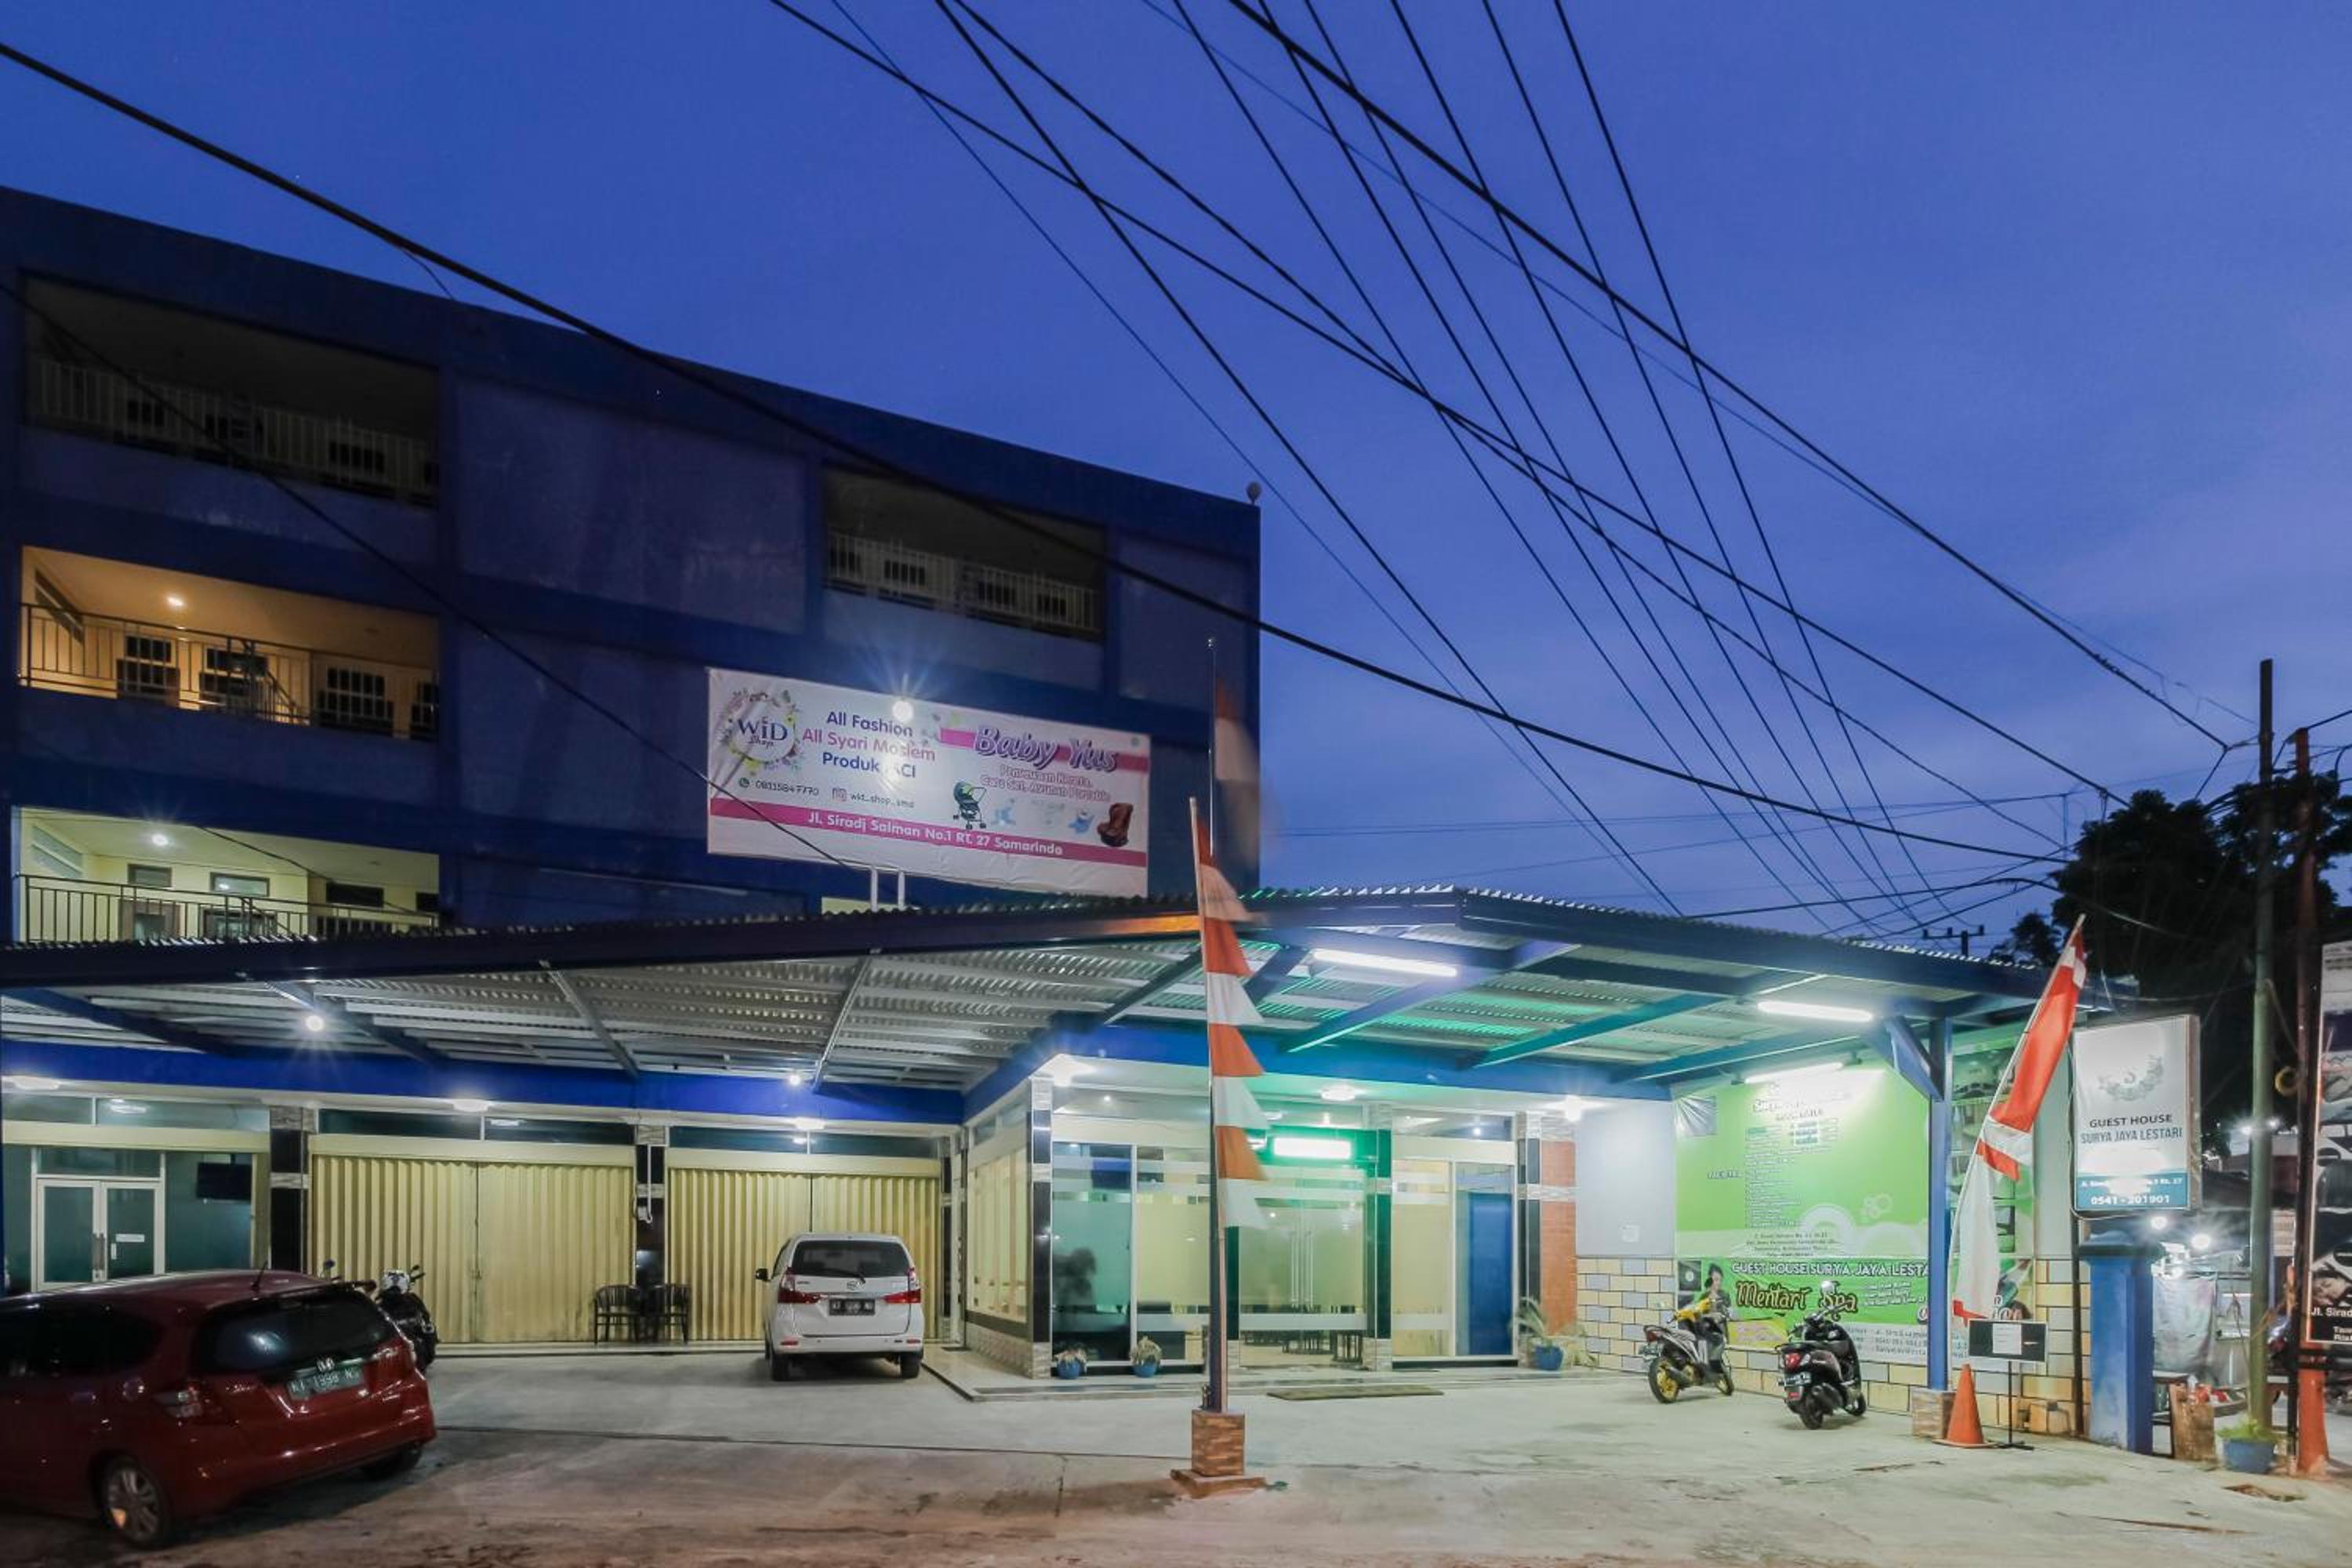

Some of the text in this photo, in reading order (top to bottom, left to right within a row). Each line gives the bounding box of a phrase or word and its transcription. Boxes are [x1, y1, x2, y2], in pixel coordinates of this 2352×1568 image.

[827, 711, 913, 738] All Fashion
[802, 728, 936, 762] All Syari Moslem
[975, 726, 1119, 772] Baby Yus
[823, 752, 879, 772] Produk
[827, 815, 866, 833] Siradj
[870, 818, 920, 837] Salman
[925, 828, 952, 842] No.1
[975, 835, 990, 847] 27
[994, 837, 1063, 855] Samarinda
[2089, 1114, 2173, 1128] GUEST HOUSE
[2081, 1127, 2183, 1144] SURYA JAYA LESTARI
[2091, 1196, 2118, 1205] 0541
[1732, 1263, 1766, 1274] GUEST
[1769, 1263, 1807, 1275] HOUSE
[1809, 1264, 1851, 1276] SURYA
[1855, 1264, 1889, 1276] JAYA
[1736, 1279, 1812, 1310] Mentari
